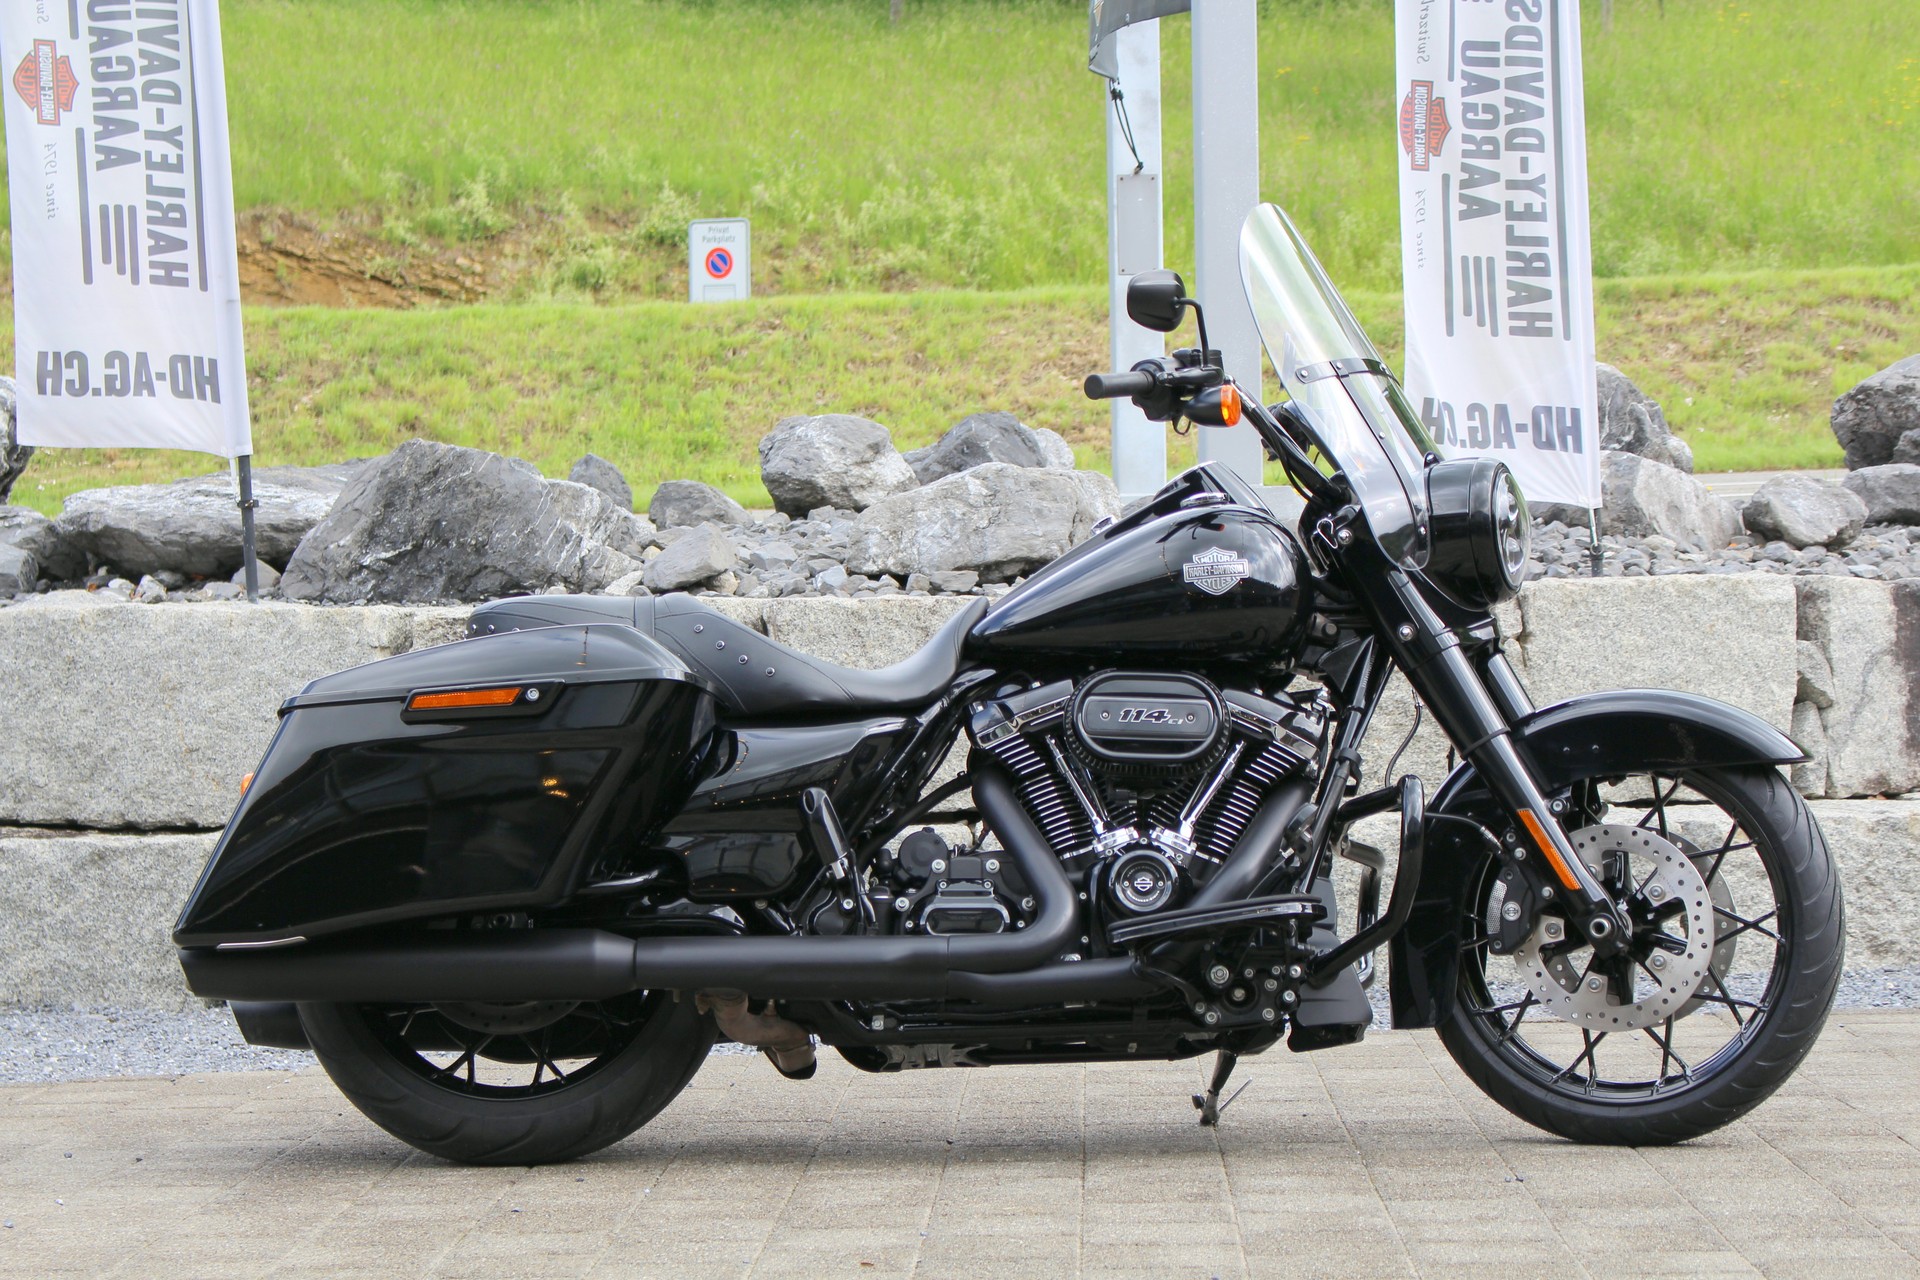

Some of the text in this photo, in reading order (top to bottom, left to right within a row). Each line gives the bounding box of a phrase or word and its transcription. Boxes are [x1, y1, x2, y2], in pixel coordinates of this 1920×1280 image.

[1201, 553, 1231, 563] MOTOR
[1188, 564, 1244, 578] HARLEY-DAVIDSON
[1202, 578, 1232, 589] CYCLES
[1118, 708, 1171, 723] 114
